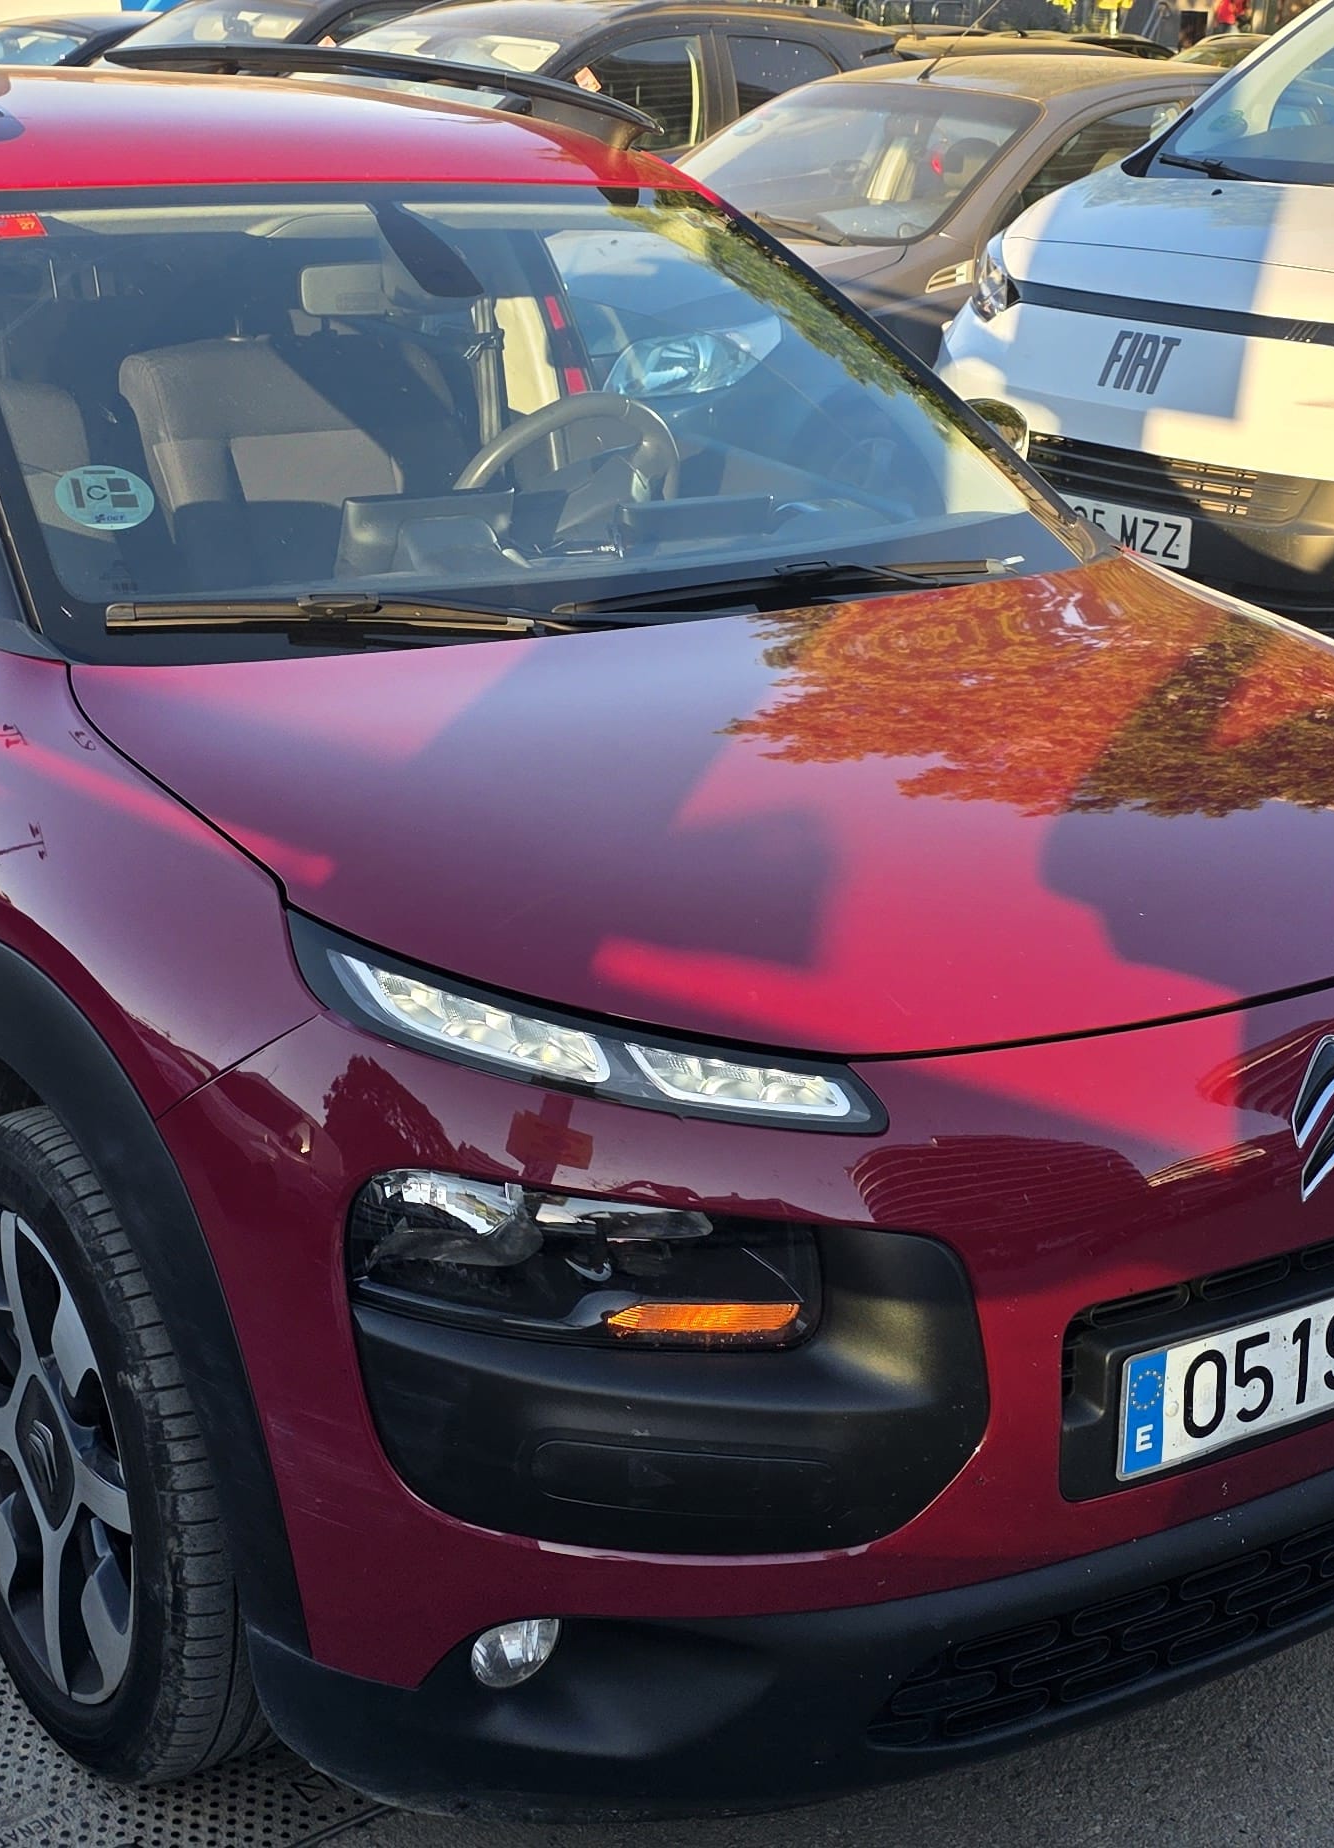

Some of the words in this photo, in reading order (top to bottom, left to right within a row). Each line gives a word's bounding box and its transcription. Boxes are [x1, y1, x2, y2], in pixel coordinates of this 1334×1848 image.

[1097, 329, 1182, 395] FIAT
[87, 485, 107, 500] C
[1120, 514, 1182, 560] MZZ
[1135, 1423, 1155, 1453] E
